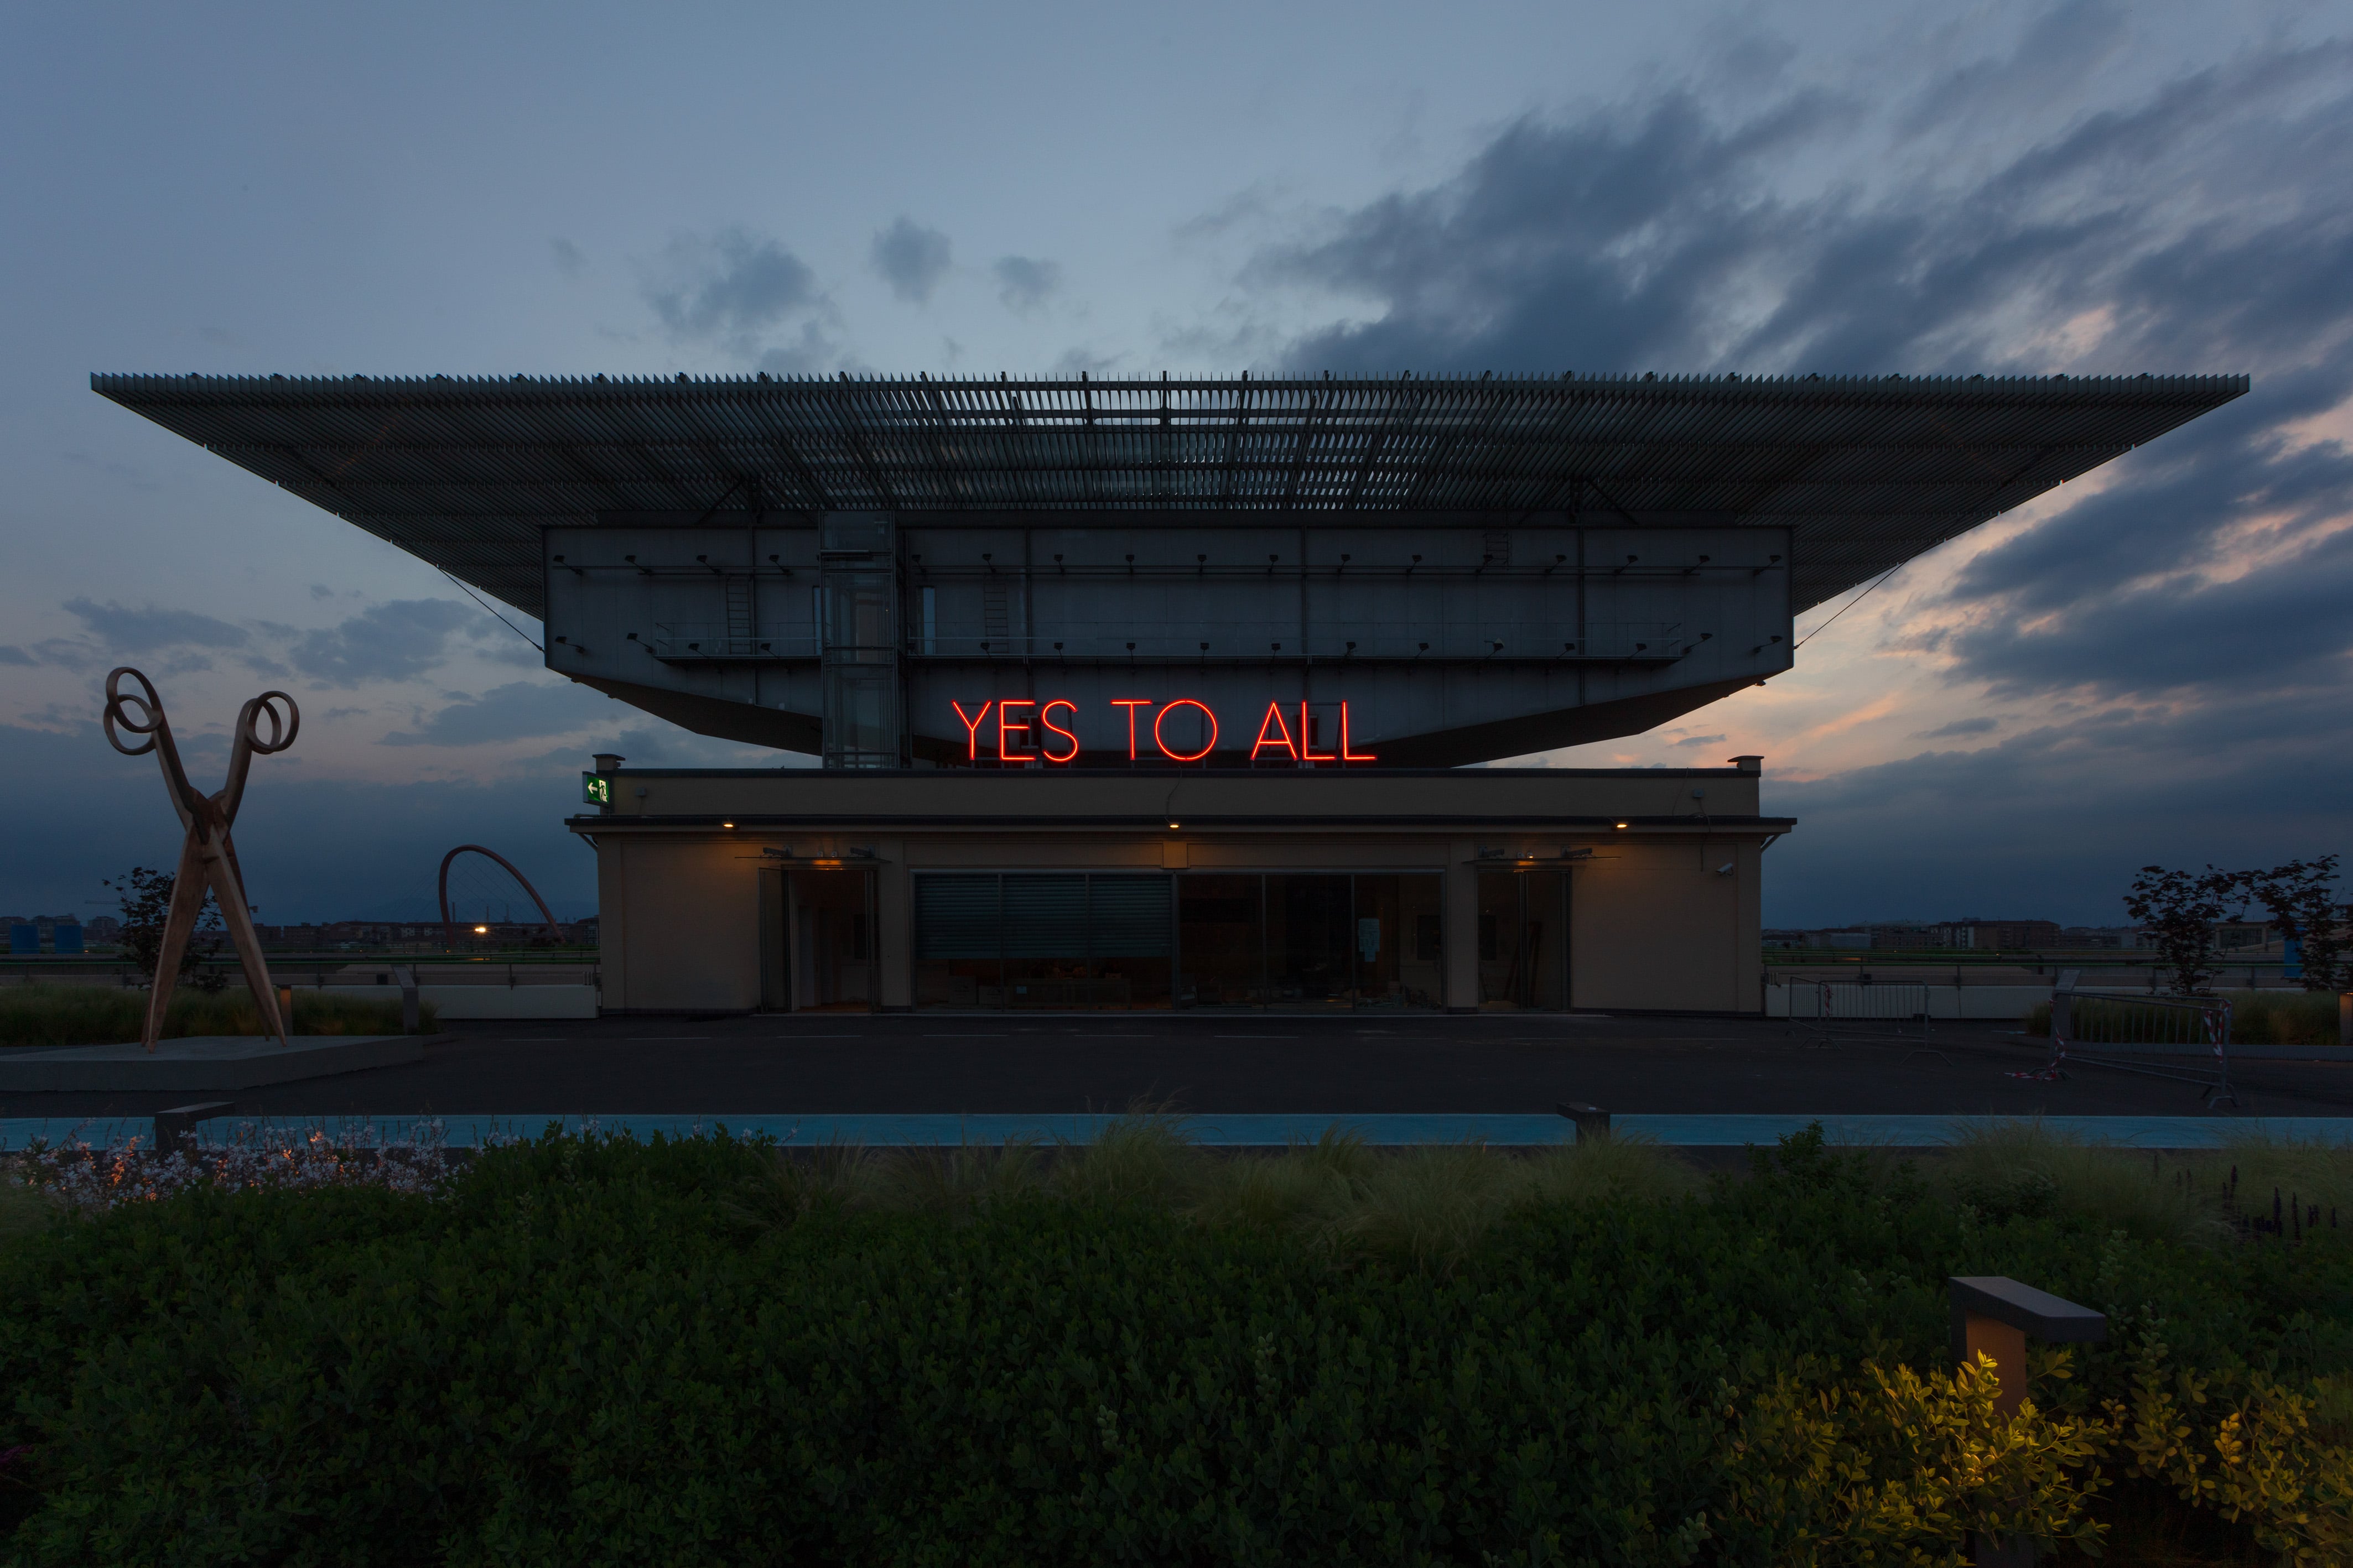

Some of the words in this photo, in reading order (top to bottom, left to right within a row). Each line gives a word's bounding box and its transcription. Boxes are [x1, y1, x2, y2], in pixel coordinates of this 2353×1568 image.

[951, 698, 1079, 762] YES
[1110, 698, 1218, 762] TO
[1250, 700, 1376, 761] ALL
